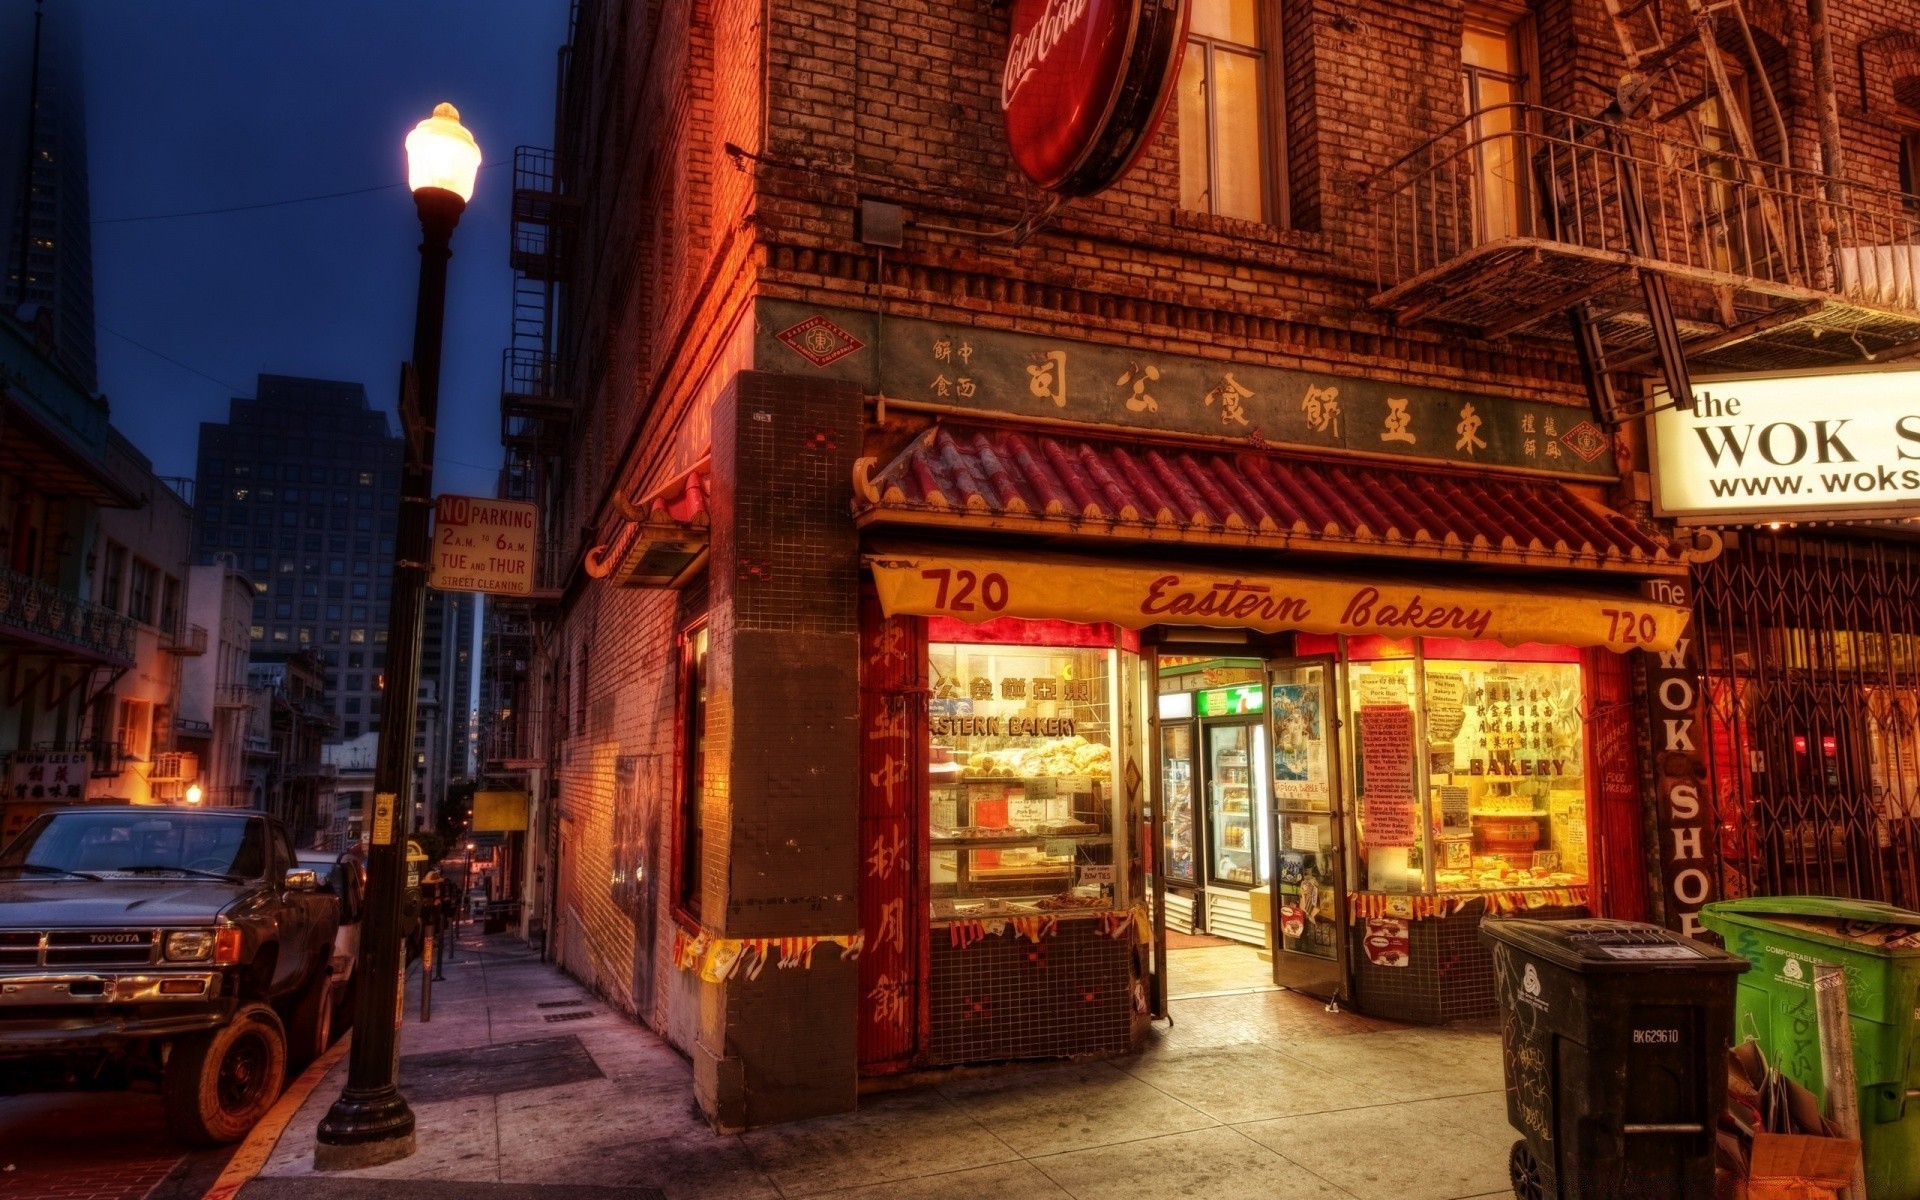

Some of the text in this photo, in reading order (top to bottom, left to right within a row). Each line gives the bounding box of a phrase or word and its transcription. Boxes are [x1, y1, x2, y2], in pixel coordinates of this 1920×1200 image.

[821, 320, 854, 343] BAKERY
[821, 344, 854, 362] CALIFORNIA
[1692, 391, 1741, 418] the
[1693, 418, 1859, 469] WOK
[439, 499, 532, 529] NO PARKING
[482, 534, 490, 542] TO
[441, 553, 524, 574] TUE AND THUR
[441, 576, 524, 591] STREET CLEANING
[1647, 579, 1685, 604] The
[921, 568, 1656, 644] 720 Eastern Bakery 720
[1656, 637, 1697, 751] WOK
[1009, 716, 1081, 737] BAKERY
[16, 754, 46, 764] MOW
[49, 754, 69, 764] LEE
[1470, 758, 1566, 776] BAKERY
[1606, 772, 1625, 783] FOOD
[1084, 872, 1111, 880] BOW TIES
[90, 933, 140, 943] TOYOTA
[1765, 945, 1823, 964] COMPOSTABLES
